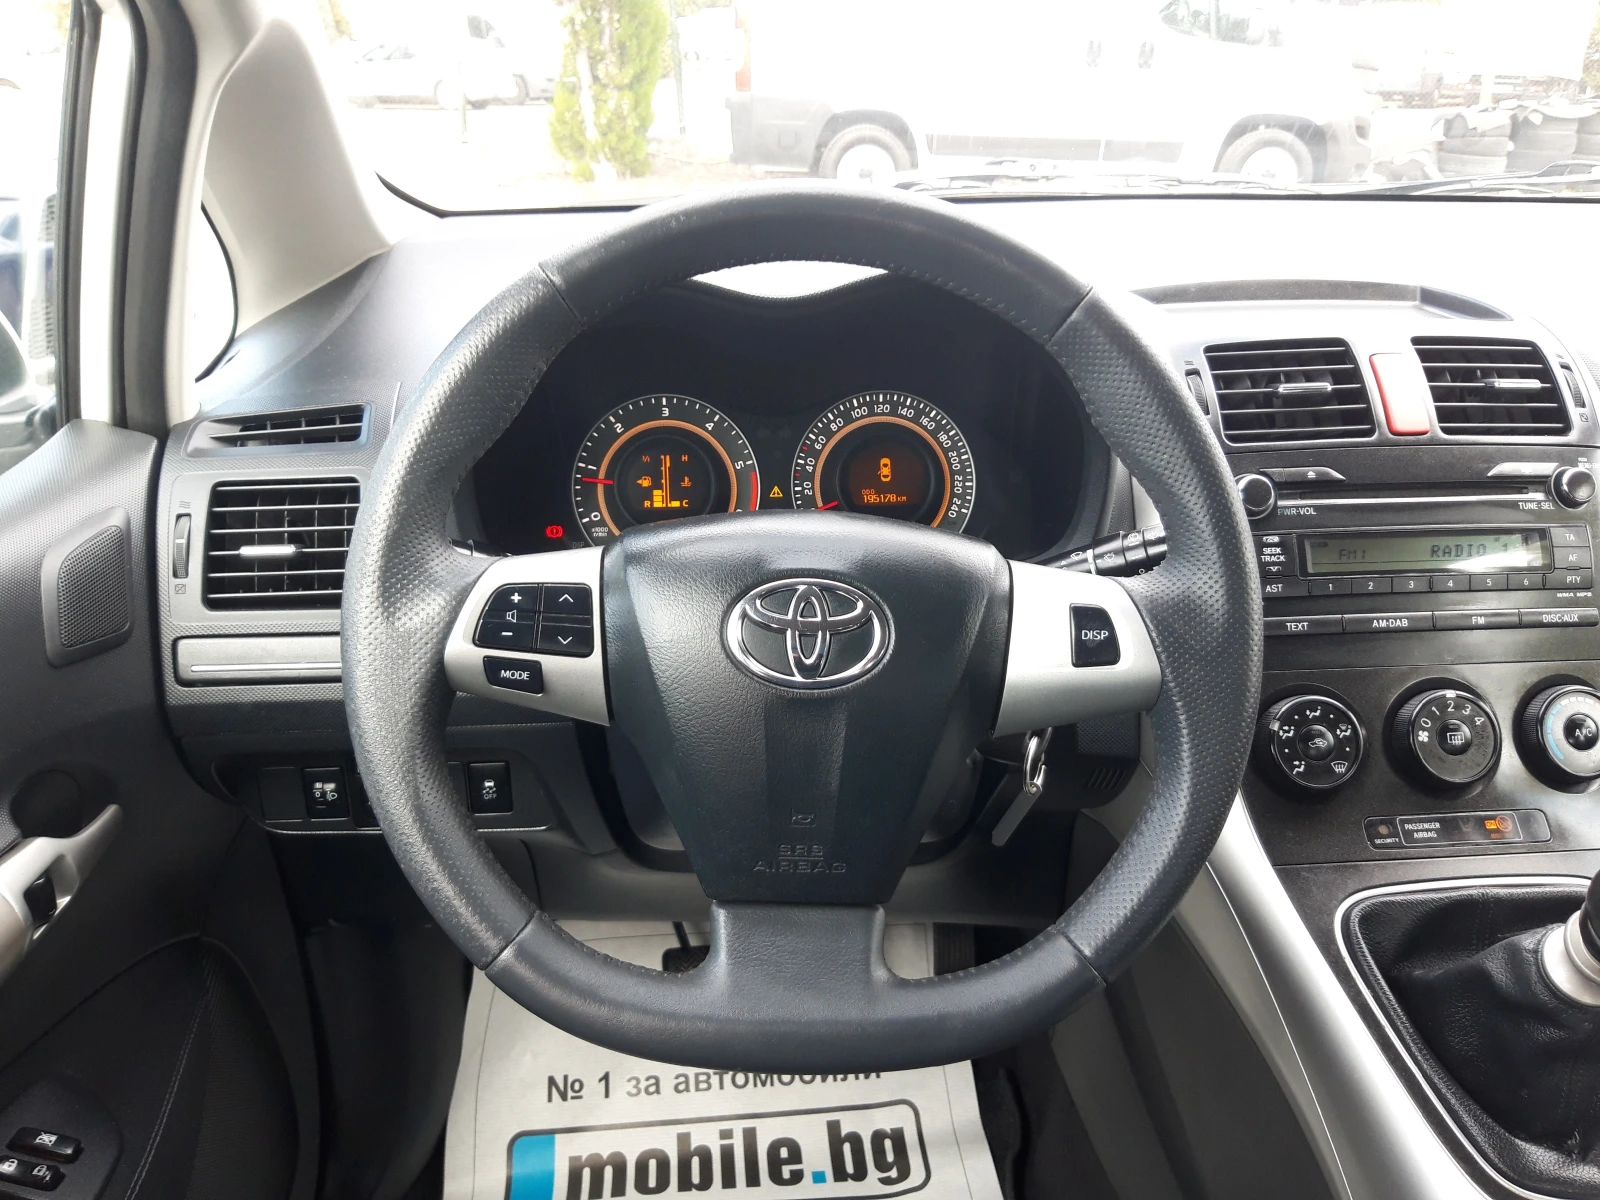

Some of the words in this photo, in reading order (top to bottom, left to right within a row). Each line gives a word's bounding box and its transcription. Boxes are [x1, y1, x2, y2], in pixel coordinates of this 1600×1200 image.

[662, 408, 669, 416] 3
[850, 406, 869, 419] 100
[874, 404, 890, 413] 120
[897, 406, 915, 418] 140
[613, 422, 624, 433] 2
[705, 422, 715, 431] 4
[830, 418, 844, 432] 80
[919, 415, 935, 430] 160
[814, 436, 827, 450] 60
[937, 431, 952, 448] 180
[735, 460, 744, 469] 5
[805, 457, 815, 473] 40
[948, 451, 961, 470] 200
[803, 481, 813, 495] 20
[954, 475, 962, 494] 220
[864, 494, 896, 503] 195178
[948, 497, 962, 518] 240
[591, 511, 601, 521] 0
[1431, 544, 1487, 558] RADIO
[1266, 584, 1283, 592] AST
[1472, 616, 1484, 624] FM
[1286, 622, 1309, 630] TEXT
[1081, 629, 1109, 640] DISP
[501, 669, 530, 680] MODE
[1431, 706, 1440, 715] 1
[1447, 700, 1455, 712] 2
[1462, 704, 1471, 714] 3
[1420, 717, 1431, 727] 0
[1474, 717, 1485, 725] 4
[1575, 728, 1592, 737] A/C
[1404, 822, 1440, 830] PASSENGER
[779, 844, 823, 856] SRS
[753, 861, 846, 873] AIRBAG
[598, 1071, 610, 1098] 1
[626, 1074, 661, 1097] за
[566, 1119, 911, 1200] mobile.bg
